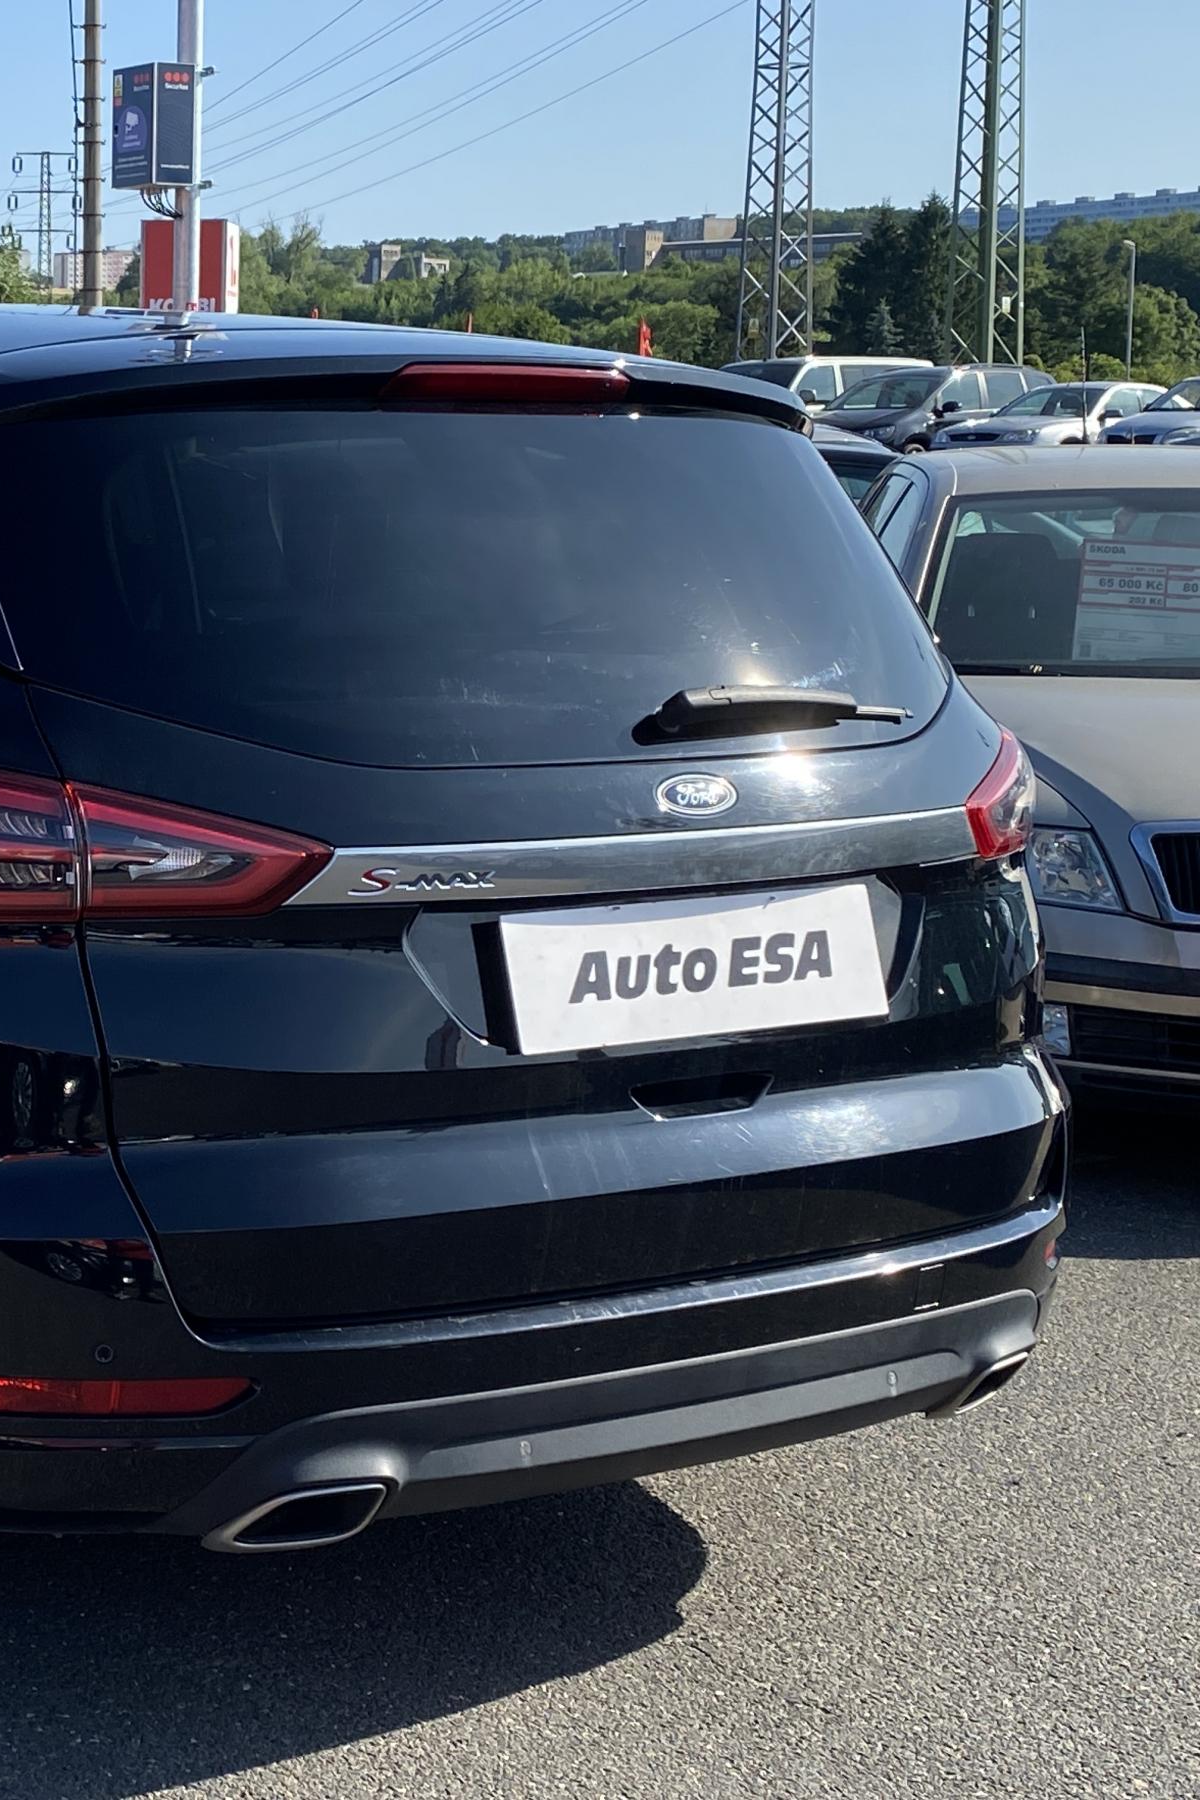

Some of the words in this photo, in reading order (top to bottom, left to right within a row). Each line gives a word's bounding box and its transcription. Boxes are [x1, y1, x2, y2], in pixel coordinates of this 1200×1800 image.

[1099, 578, 1114, 588] 65
[1118, 579, 1142, 589] 000
[1146, 580, 1164, 591] Kč
[676, 783, 725, 805] Ford
[347, 866, 497, 897] S-MAX
[568, 943, 717, 1004] Auto
[728, 930, 833, 988] ESA
